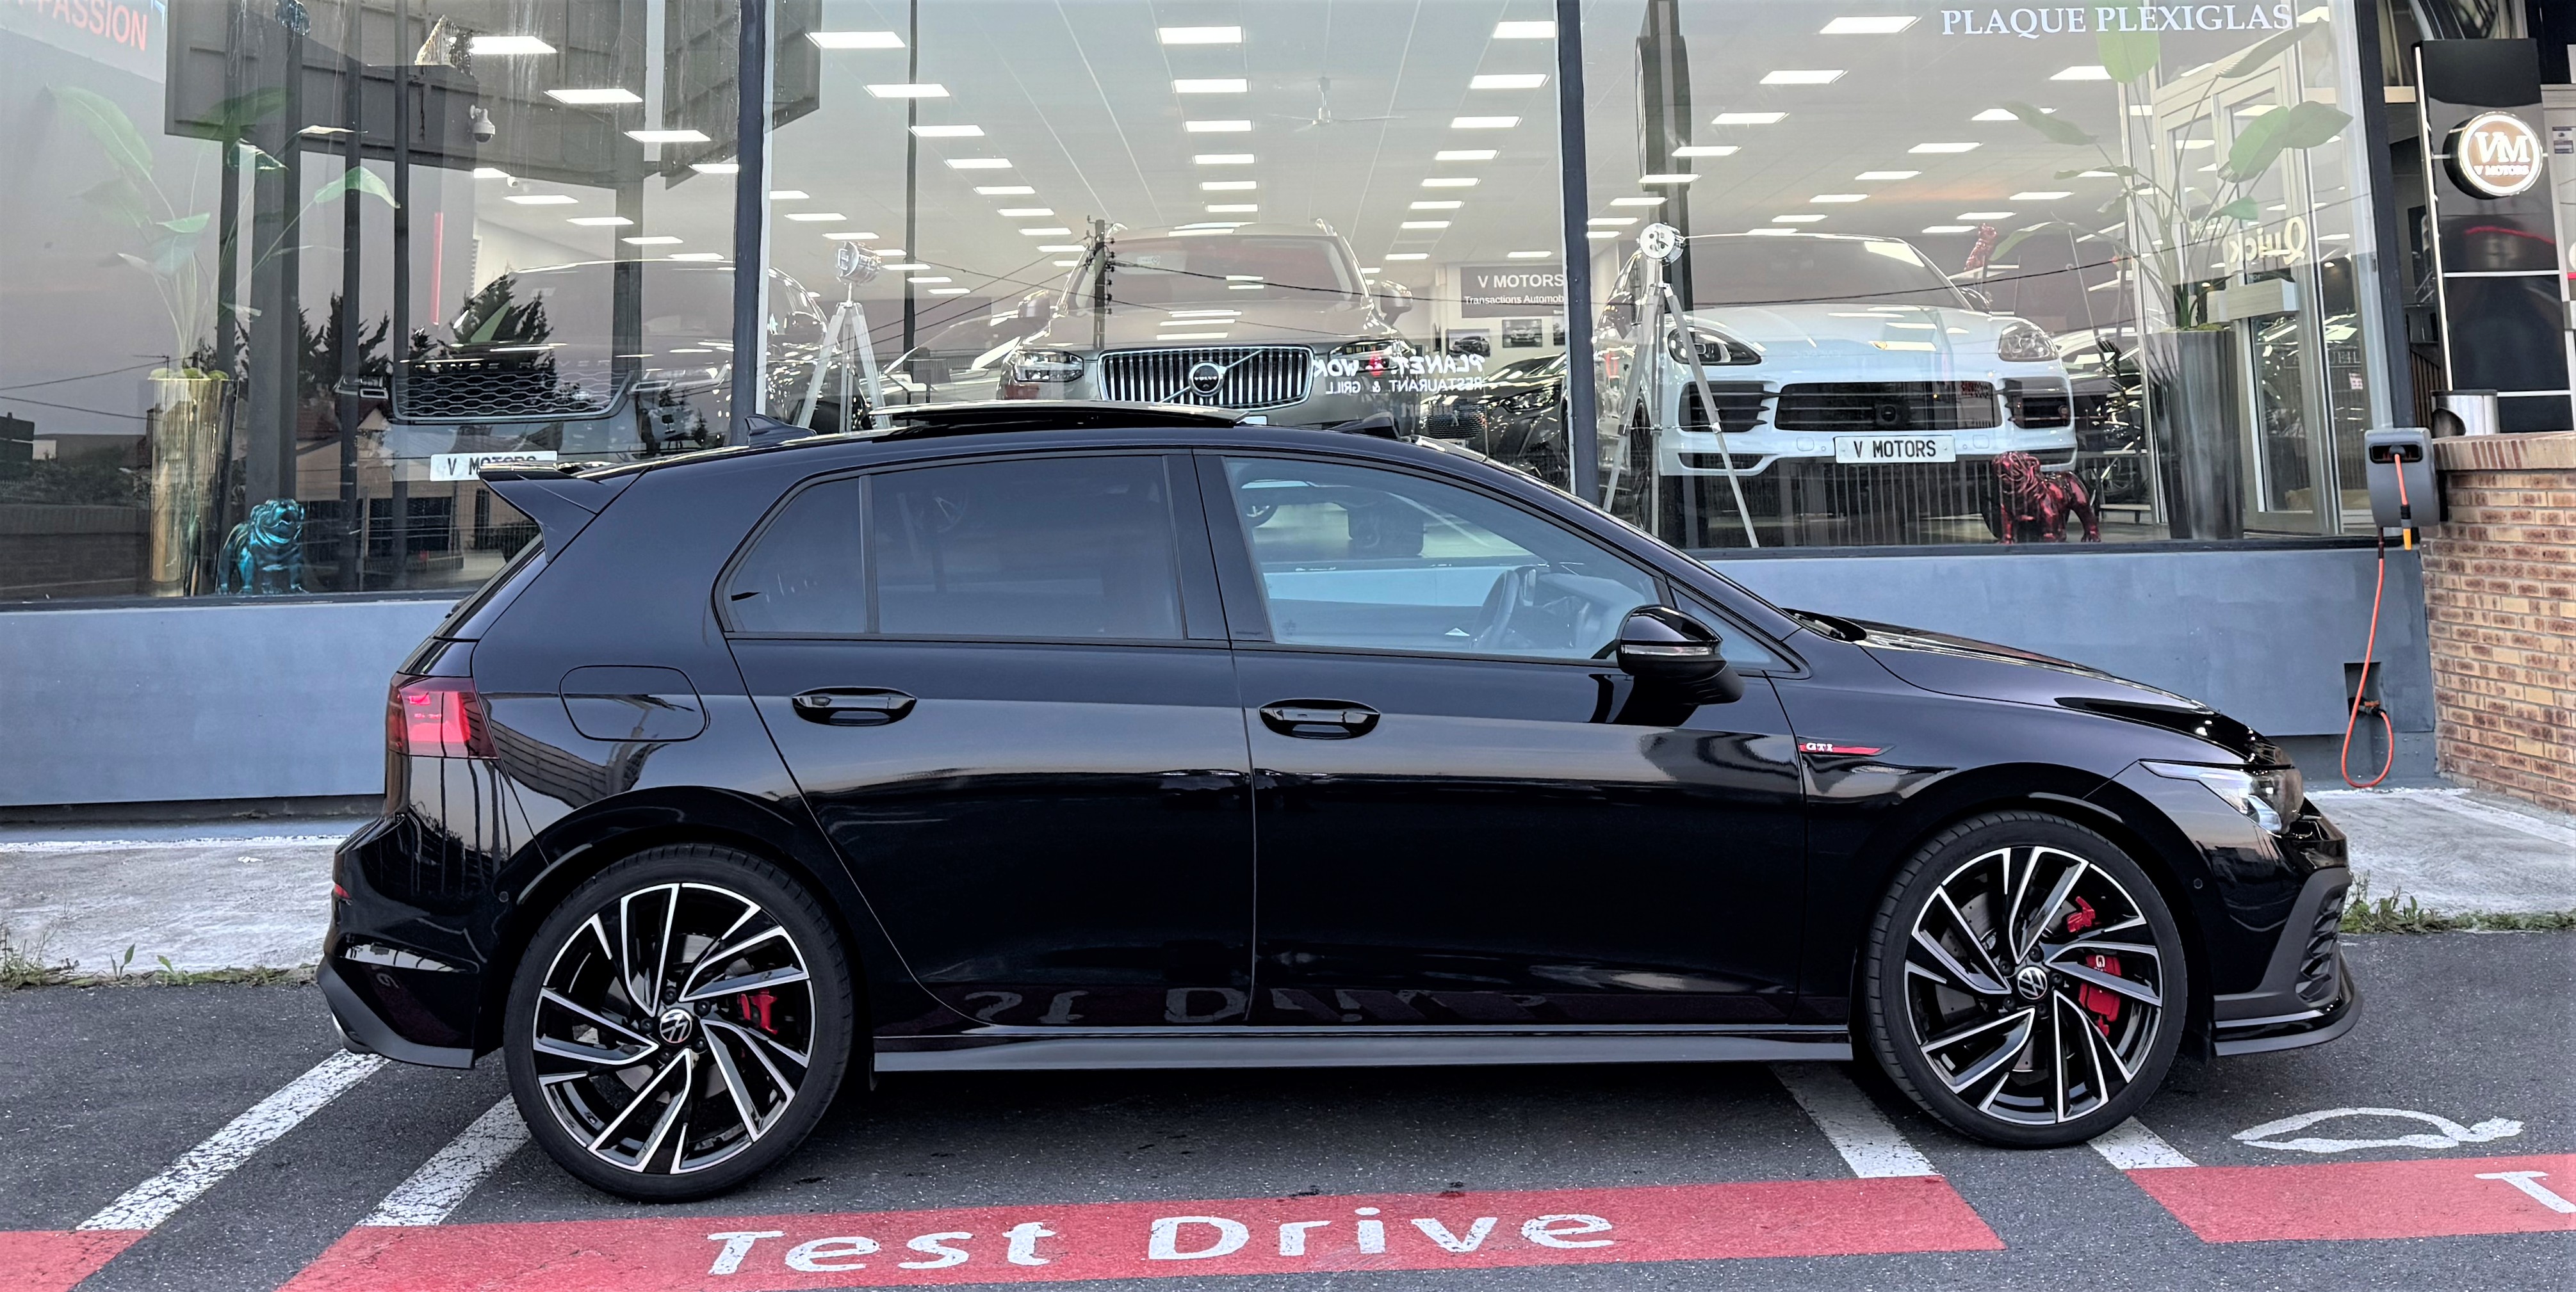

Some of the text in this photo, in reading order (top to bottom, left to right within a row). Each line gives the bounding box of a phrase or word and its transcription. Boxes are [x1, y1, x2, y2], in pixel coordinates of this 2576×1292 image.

[1941, 4, 2293, 39] PLAQUE PLEXIGLAS
[2474, 131, 2531, 163] VM
[2474, 165, 2531, 176] V MOTORS
[1478, 274, 1563, 288] V MOTORS
[1463, 295, 1522, 305] Transactions
[1854, 440, 1937, 458] V MOTORS
[1806, 742, 1834, 752] GTI
[706, 1206, 1614, 1275] Test Drive
